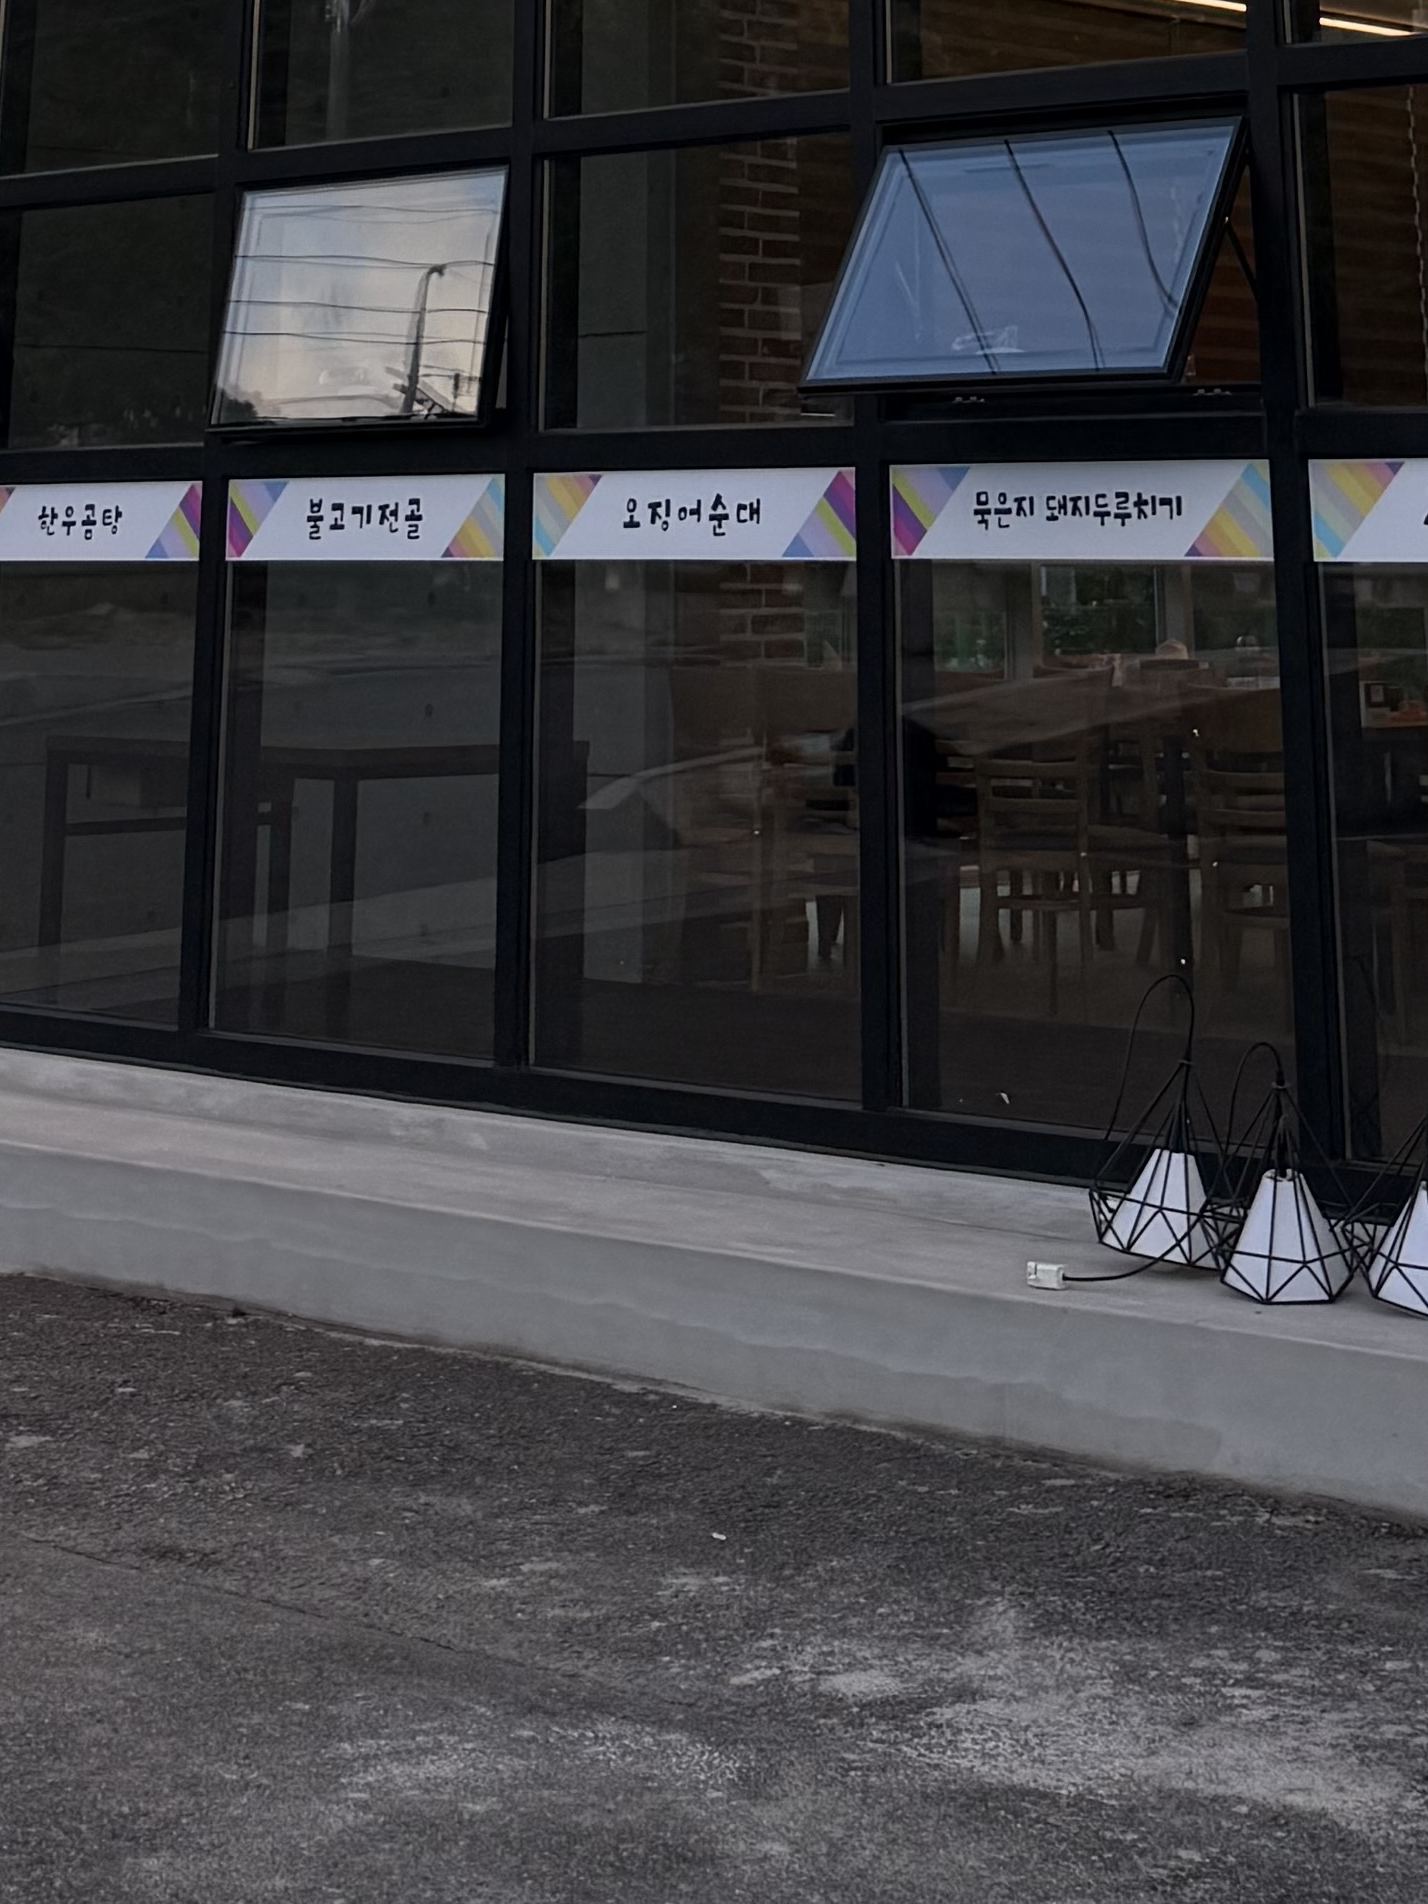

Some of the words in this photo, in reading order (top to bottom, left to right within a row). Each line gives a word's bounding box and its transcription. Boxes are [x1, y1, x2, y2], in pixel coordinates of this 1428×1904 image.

[37, 503, 123, 541] 한우곰탕
[306, 497, 424, 541] 불고기전골
[622, 493, 761, 537] 오징어순대
[973, 490, 1035, 531] 묵은지
[1045, 491, 1183, 527] 돼지두루치기
